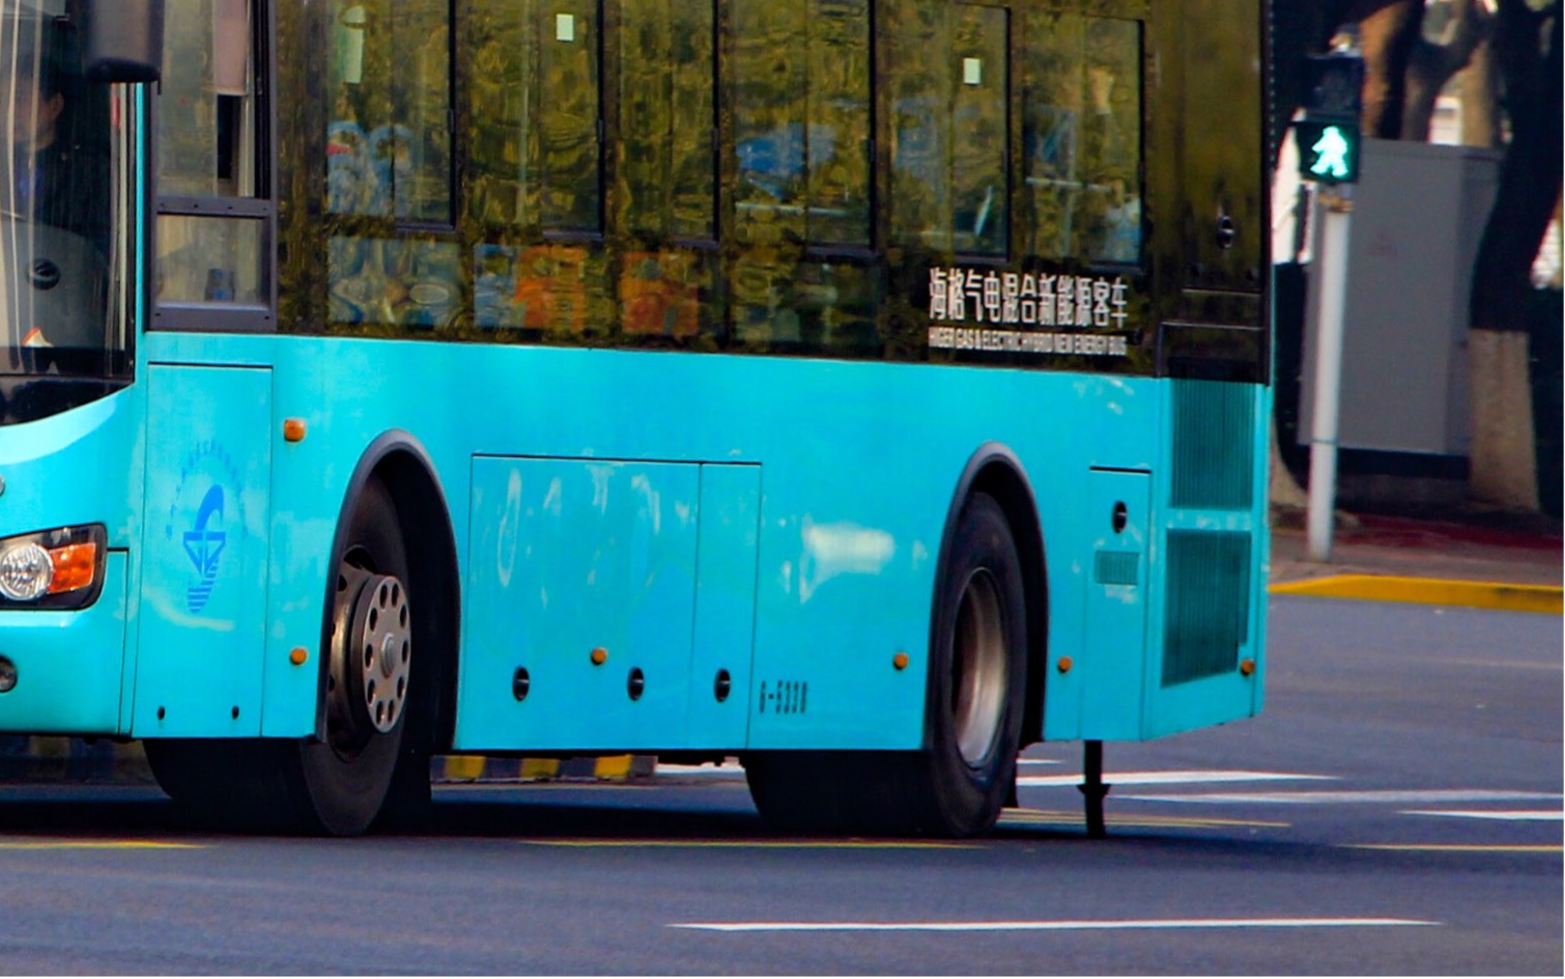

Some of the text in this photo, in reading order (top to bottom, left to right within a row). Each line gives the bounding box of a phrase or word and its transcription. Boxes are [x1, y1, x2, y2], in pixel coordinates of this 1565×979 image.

[929, 266, 1128, 329] 海格气电混合新能源客车
